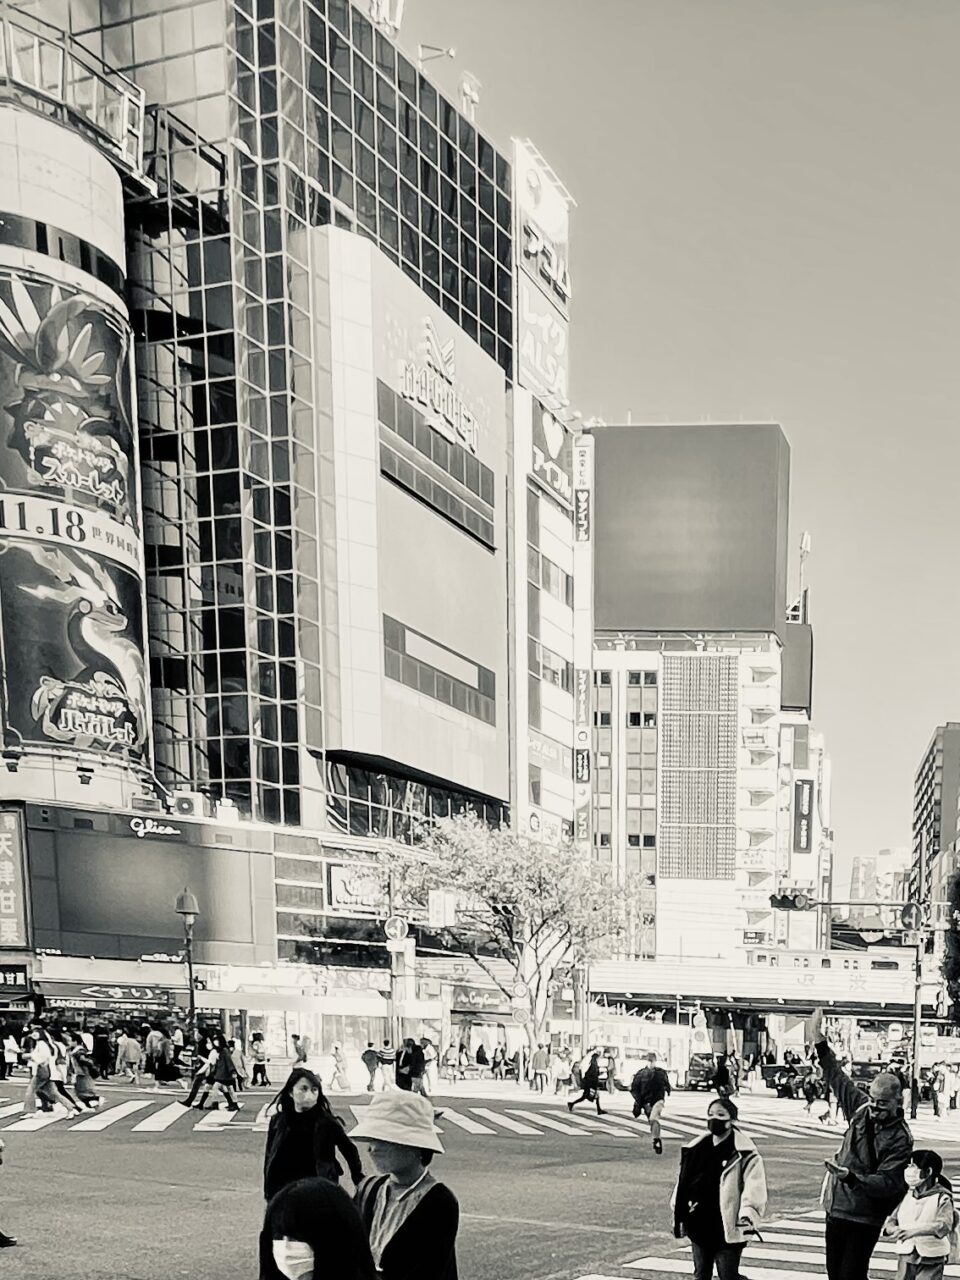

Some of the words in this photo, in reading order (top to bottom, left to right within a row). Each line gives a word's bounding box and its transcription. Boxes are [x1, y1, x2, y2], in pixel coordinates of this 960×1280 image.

[398, 359, 481, 455] MAGNET
[533, 444, 572, 499] アイフル
[0, 499, 87, 542] 11.18
[577, 502, 589, 541] アイフル
[130, 817, 182, 838] Glico
